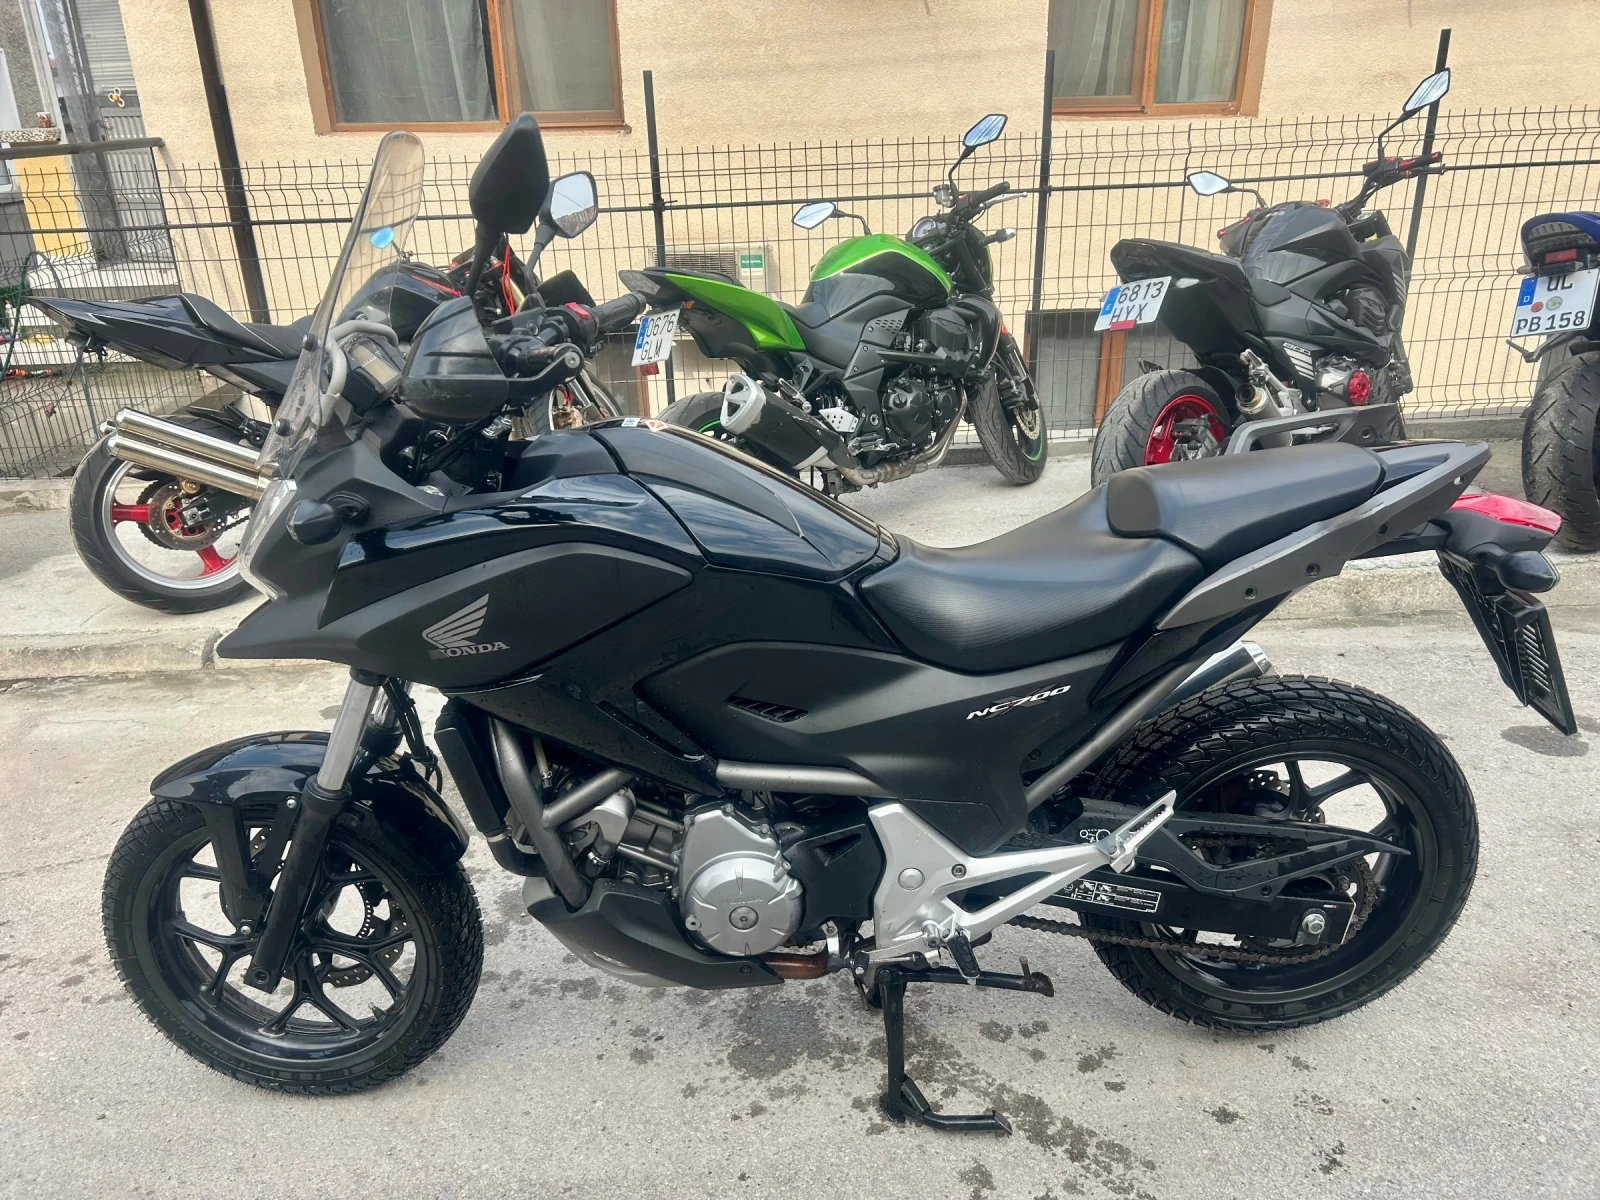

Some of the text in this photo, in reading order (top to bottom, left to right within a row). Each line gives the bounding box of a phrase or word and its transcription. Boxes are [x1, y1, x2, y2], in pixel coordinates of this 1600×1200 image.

[1118, 281, 1164, 304] 6813
[1547, 274, 1573, 292] UL
[1523, 295, 1530, 303] D
[646, 313, 676, 338] 0676
[1109, 302, 1148, 326] HYX
[1515, 310, 1585, 334] PB 158
[966, 684, 1072, 720] NC700
